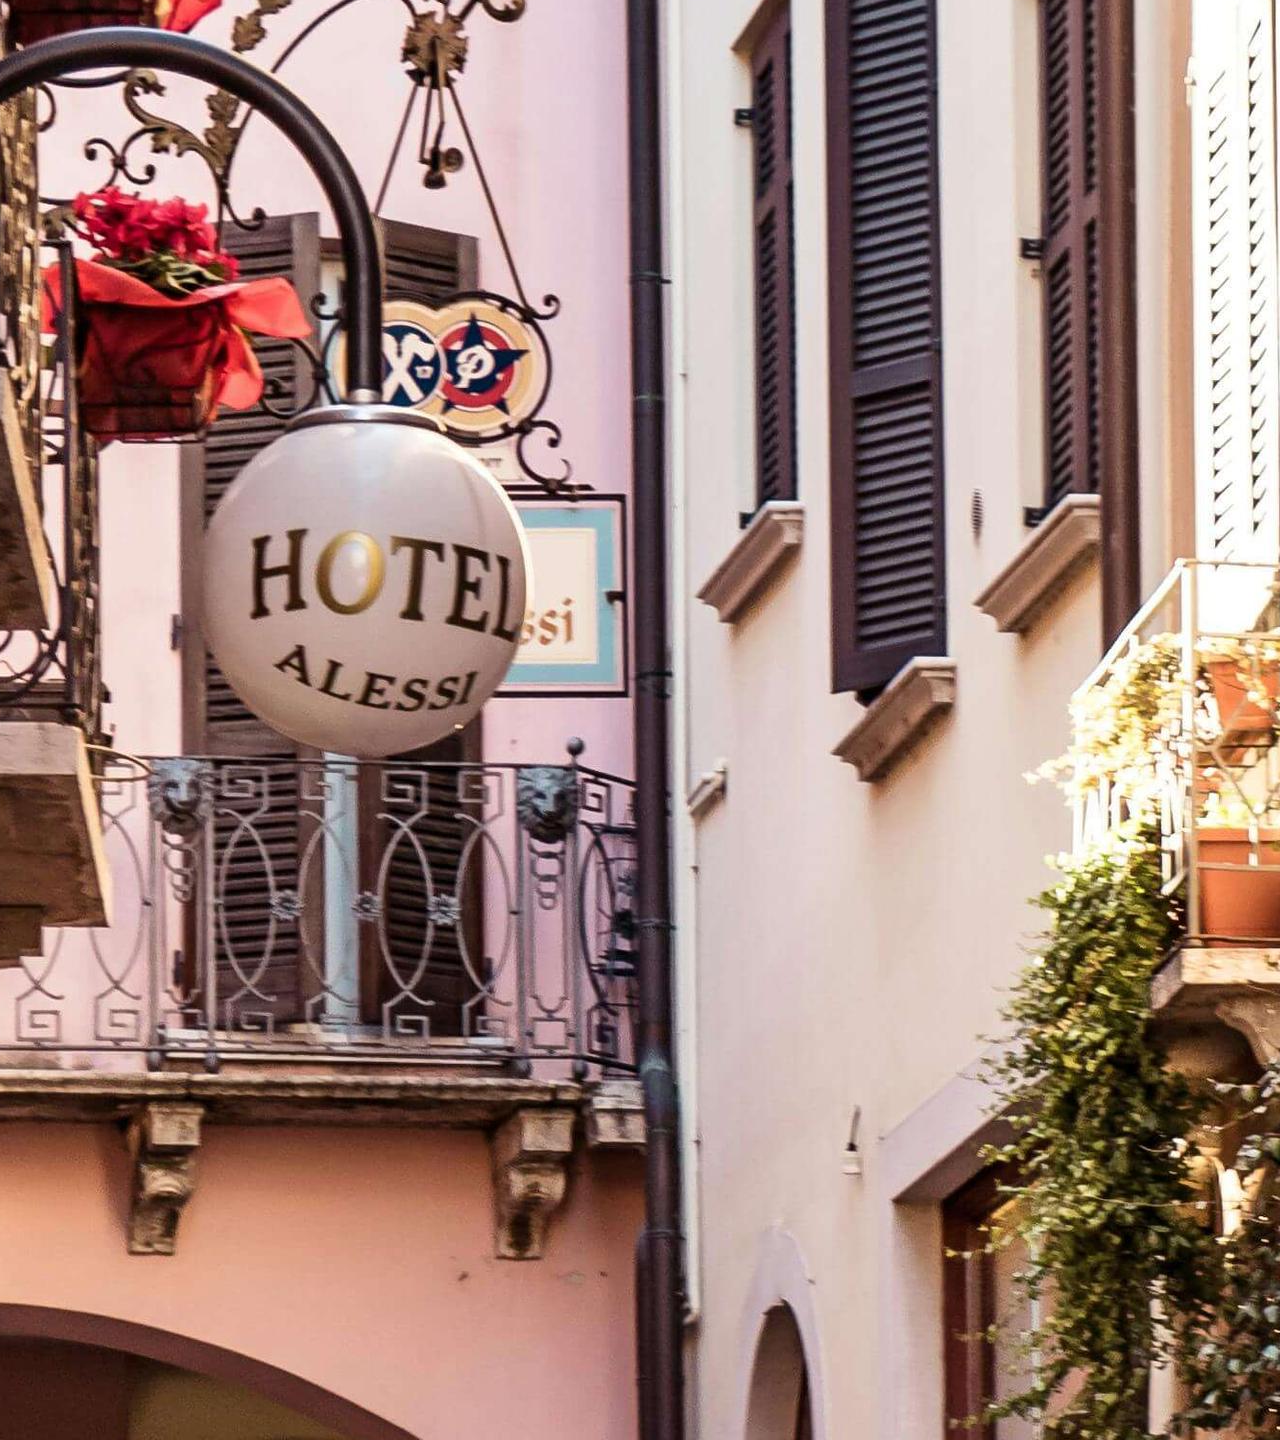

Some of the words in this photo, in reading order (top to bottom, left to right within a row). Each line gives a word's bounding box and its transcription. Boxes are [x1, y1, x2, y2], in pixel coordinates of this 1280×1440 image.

[249, 528, 517, 643] HOTEL
[519, 597, 575, 647] ssi
[274, 643, 479, 714] ALESSI
